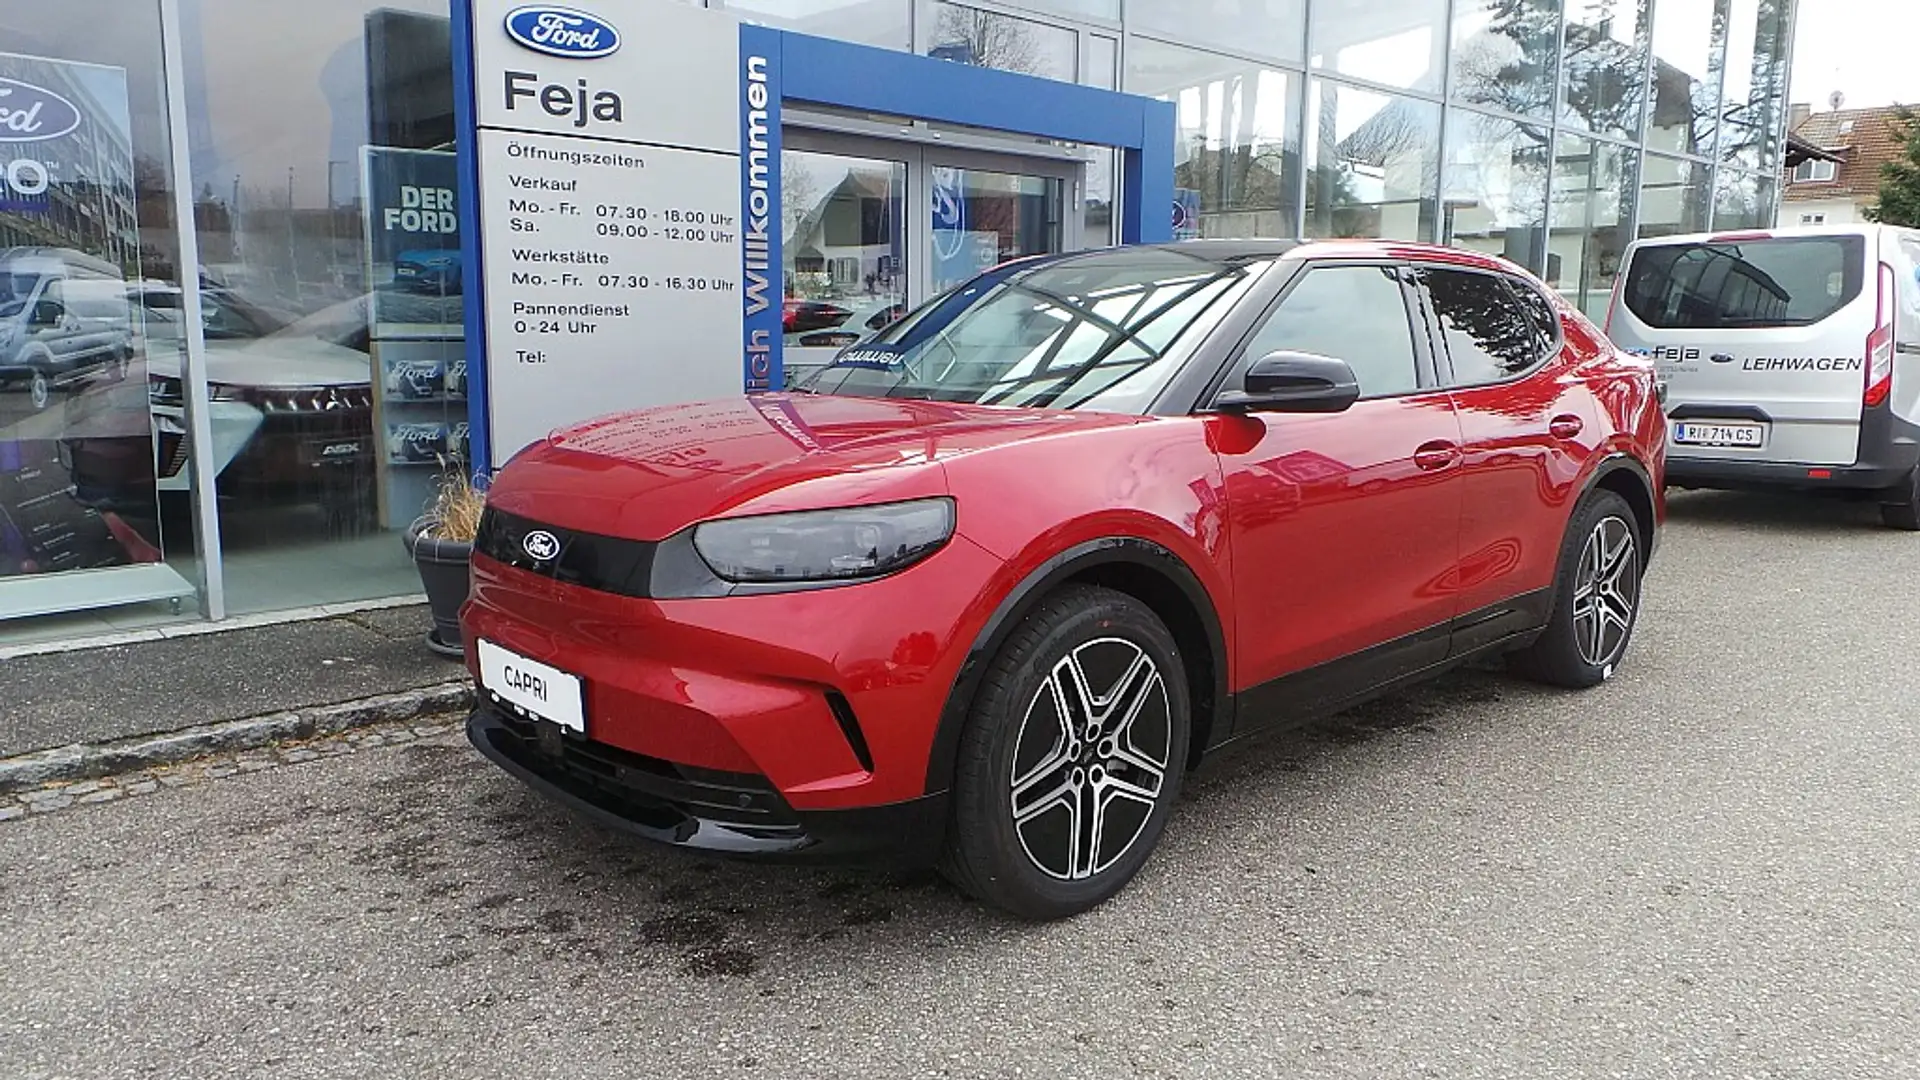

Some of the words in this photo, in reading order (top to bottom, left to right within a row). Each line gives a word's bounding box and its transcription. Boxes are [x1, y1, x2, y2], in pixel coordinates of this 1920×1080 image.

[531, 12, 600, 50] Ford
[504, 70, 623, 128] Feja
[507, 141, 645, 168] Öffnungszeiten
[509, 174, 577, 192] Verkauf
[745, 55, 769, 316] Willkommen
[401, 185, 454, 211] DER
[384, 208, 457, 234] FORD
[509, 199, 545, 214] Mo.
[560, 202, 581, 216] Fr.
[596, 204, 647, 220] 07.30
[664, 209, 705, 225] 18.00
[710, 212, 734, 226] Uhr
[510, 217, 540, 232] Sa.
[596, 222, 648, 238] 09.00
[664, 228, 705, 242] 12.00
[710, 230, 735, 244] Uhr
[512, 248, 609, 265] Werkstätte
[511, 272, 547, 287] Mo.
[562, 274, 583, 288] Fr.
[598, 275, 649, 289] 07.30
[712, 279, 735, 292] Uhr
[513, 302, 630, 317] Pannendienst
[568, 320, 598, 335] Uhr
[516, 350, 546, 364] Tel:
[1742, 357, 1862, 371] LEIHWAGEN
[504, 665, 548, 703] CAPRI
